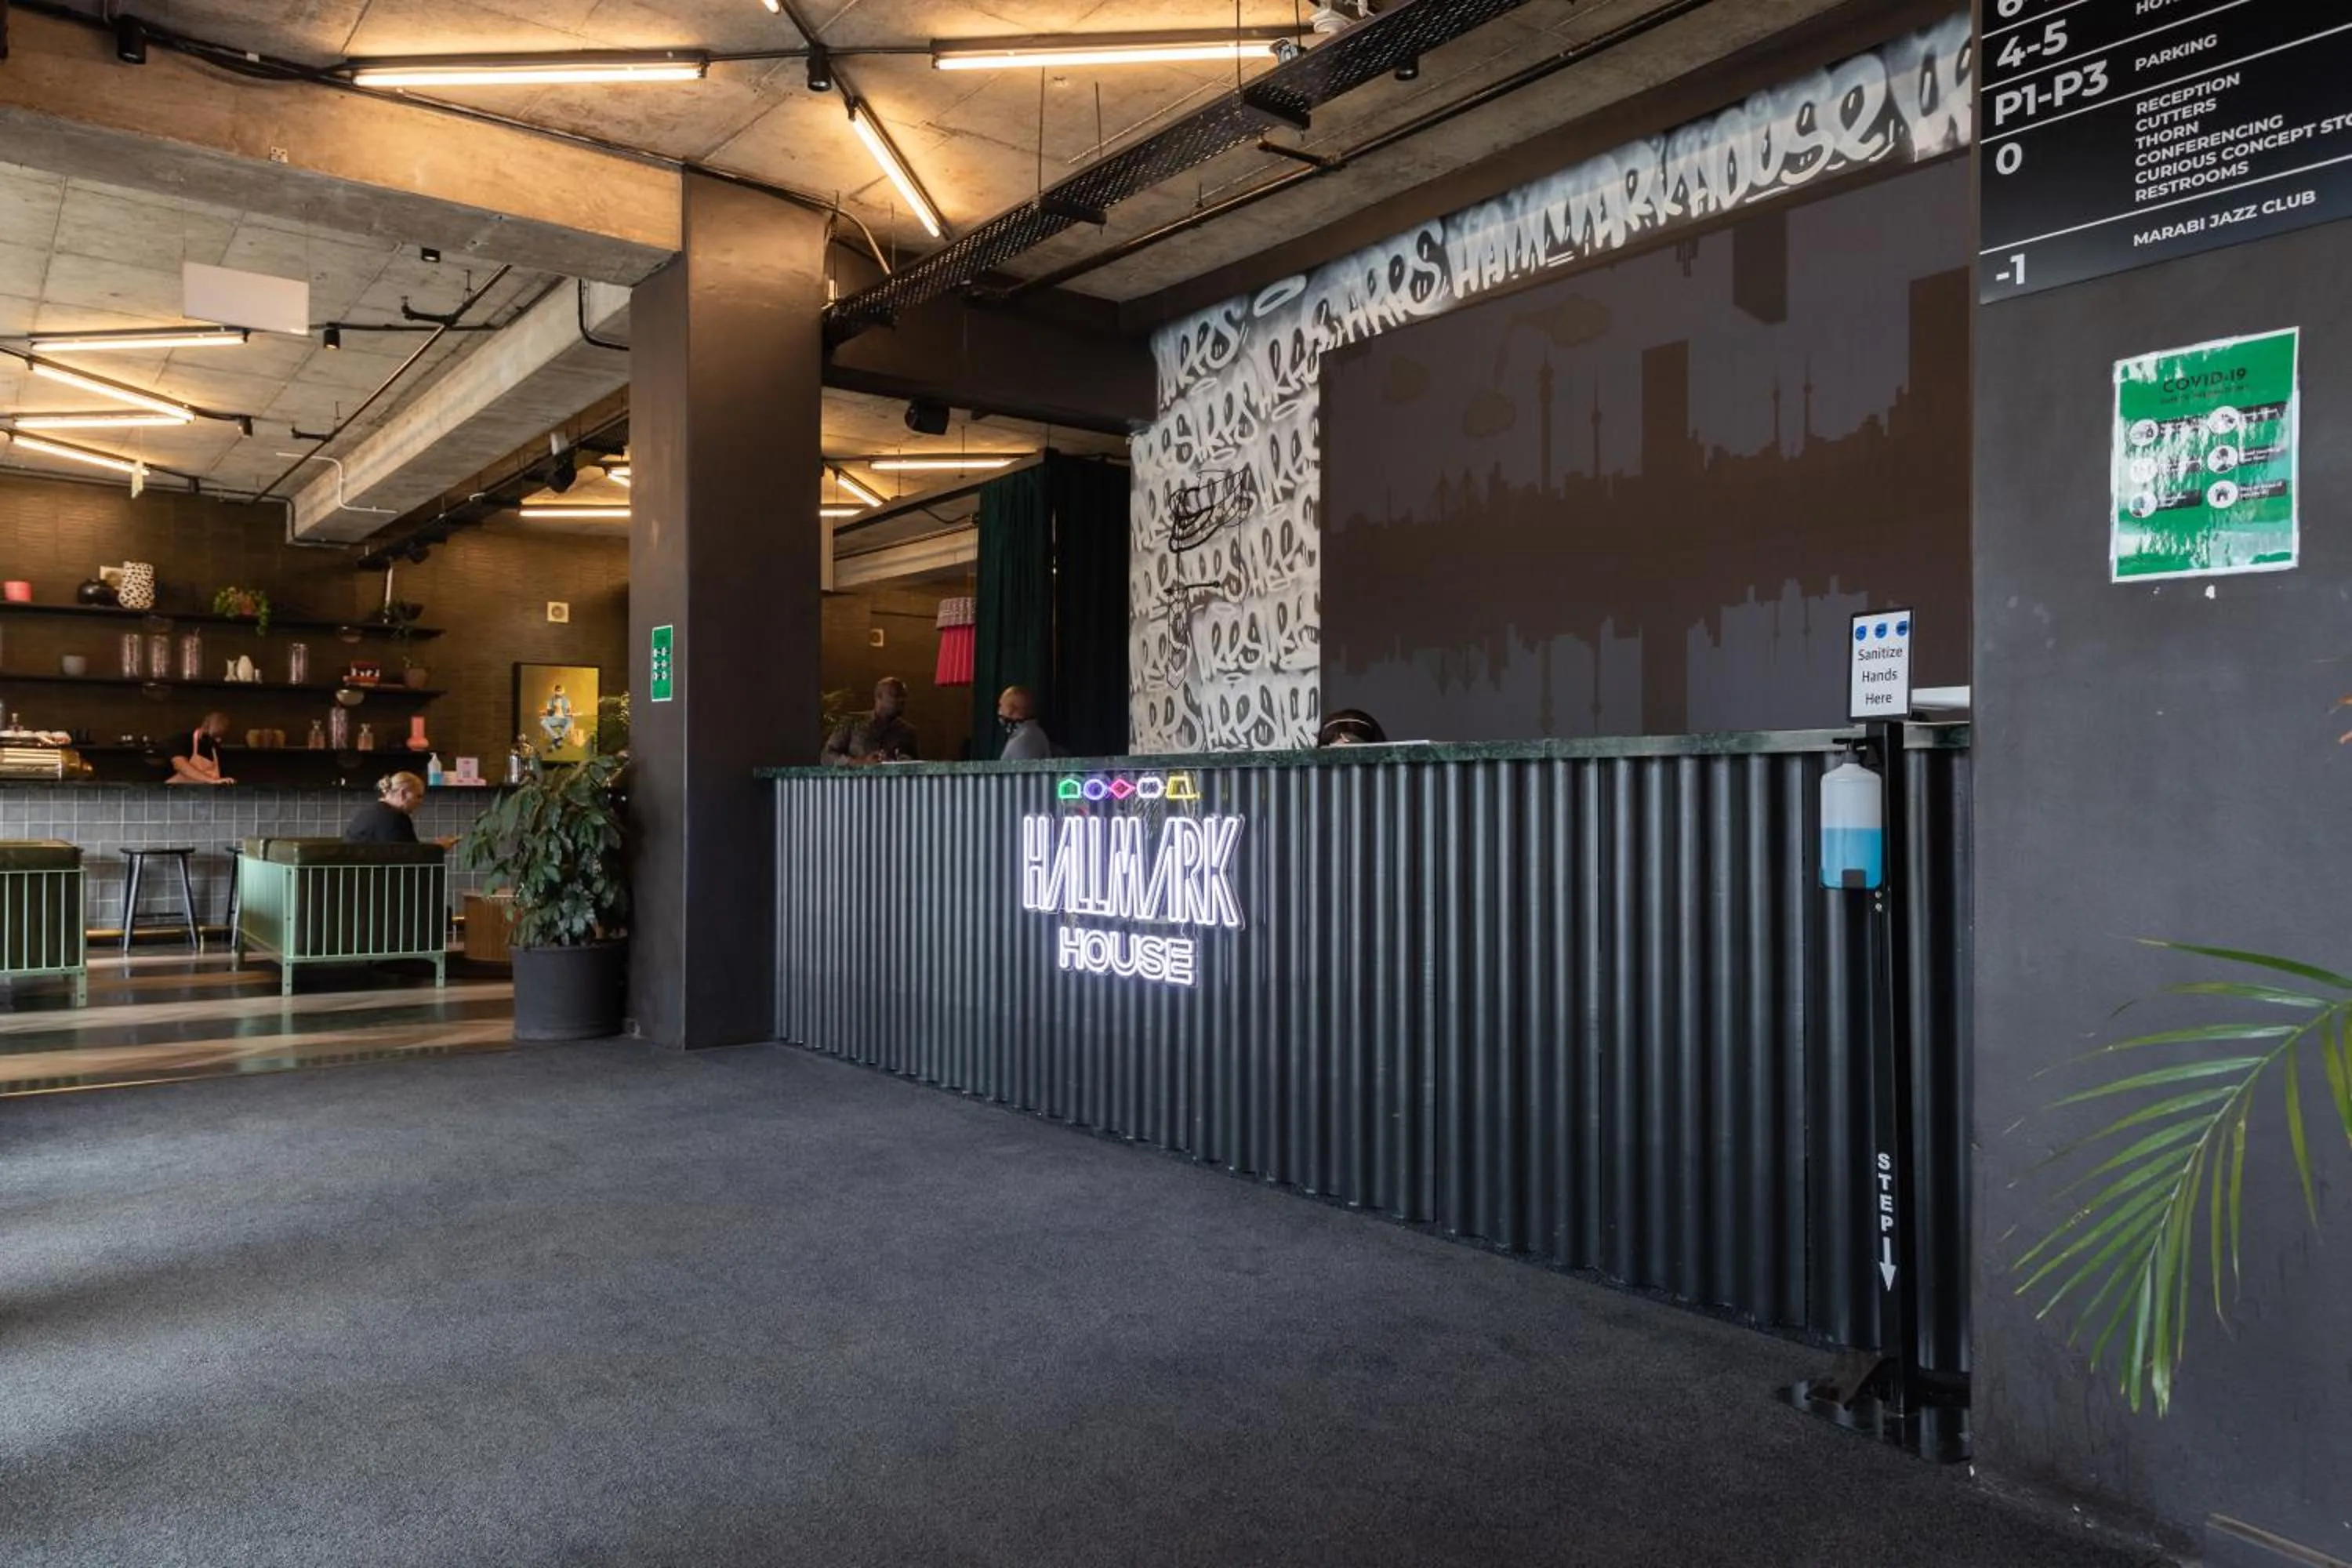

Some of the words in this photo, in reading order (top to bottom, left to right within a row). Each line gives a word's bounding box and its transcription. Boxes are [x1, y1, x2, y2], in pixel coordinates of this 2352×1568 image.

[1996, 19, 2068, 67] 4-5
[2134, 34, 2218, 71] PARKING
[1995, 60, 2108, 125] P1-P3
[2136, 72, 2241, 115] RECEPTION
[2135, 98, 2217, 132] CUTTERS
[2135, 121, 2199, 150] THORN
[2135, 114, 2284, 167] CONFERENCING
[2135, 152, 2217, 184] CURIOUS
[2221, 123, 2317, 161] CONCEPT
[1995, 143, 2023, 175] 0
[2135, 161, 2249, 201] RESTROOMS
[2133, 220, 2205, 247] MARABI
[2209, 205, 2258, 228] JAZZ
[2262, 190, 2316, 215] CLUB
[1995, 253, 2026, 285] -1
[2163, 368, 2246, 393] COVID-19
[1858, 646, 1903, 662] Sanitize
[1862, 668, 1898, 684] Hands
[1865, 692, 1893, 706] Here
[1023, 815, 1243, 928] HALLMARK
[1059, 926, 1194, 985] HOUSE
[1878, 1152, 1893, 1232] STEP
